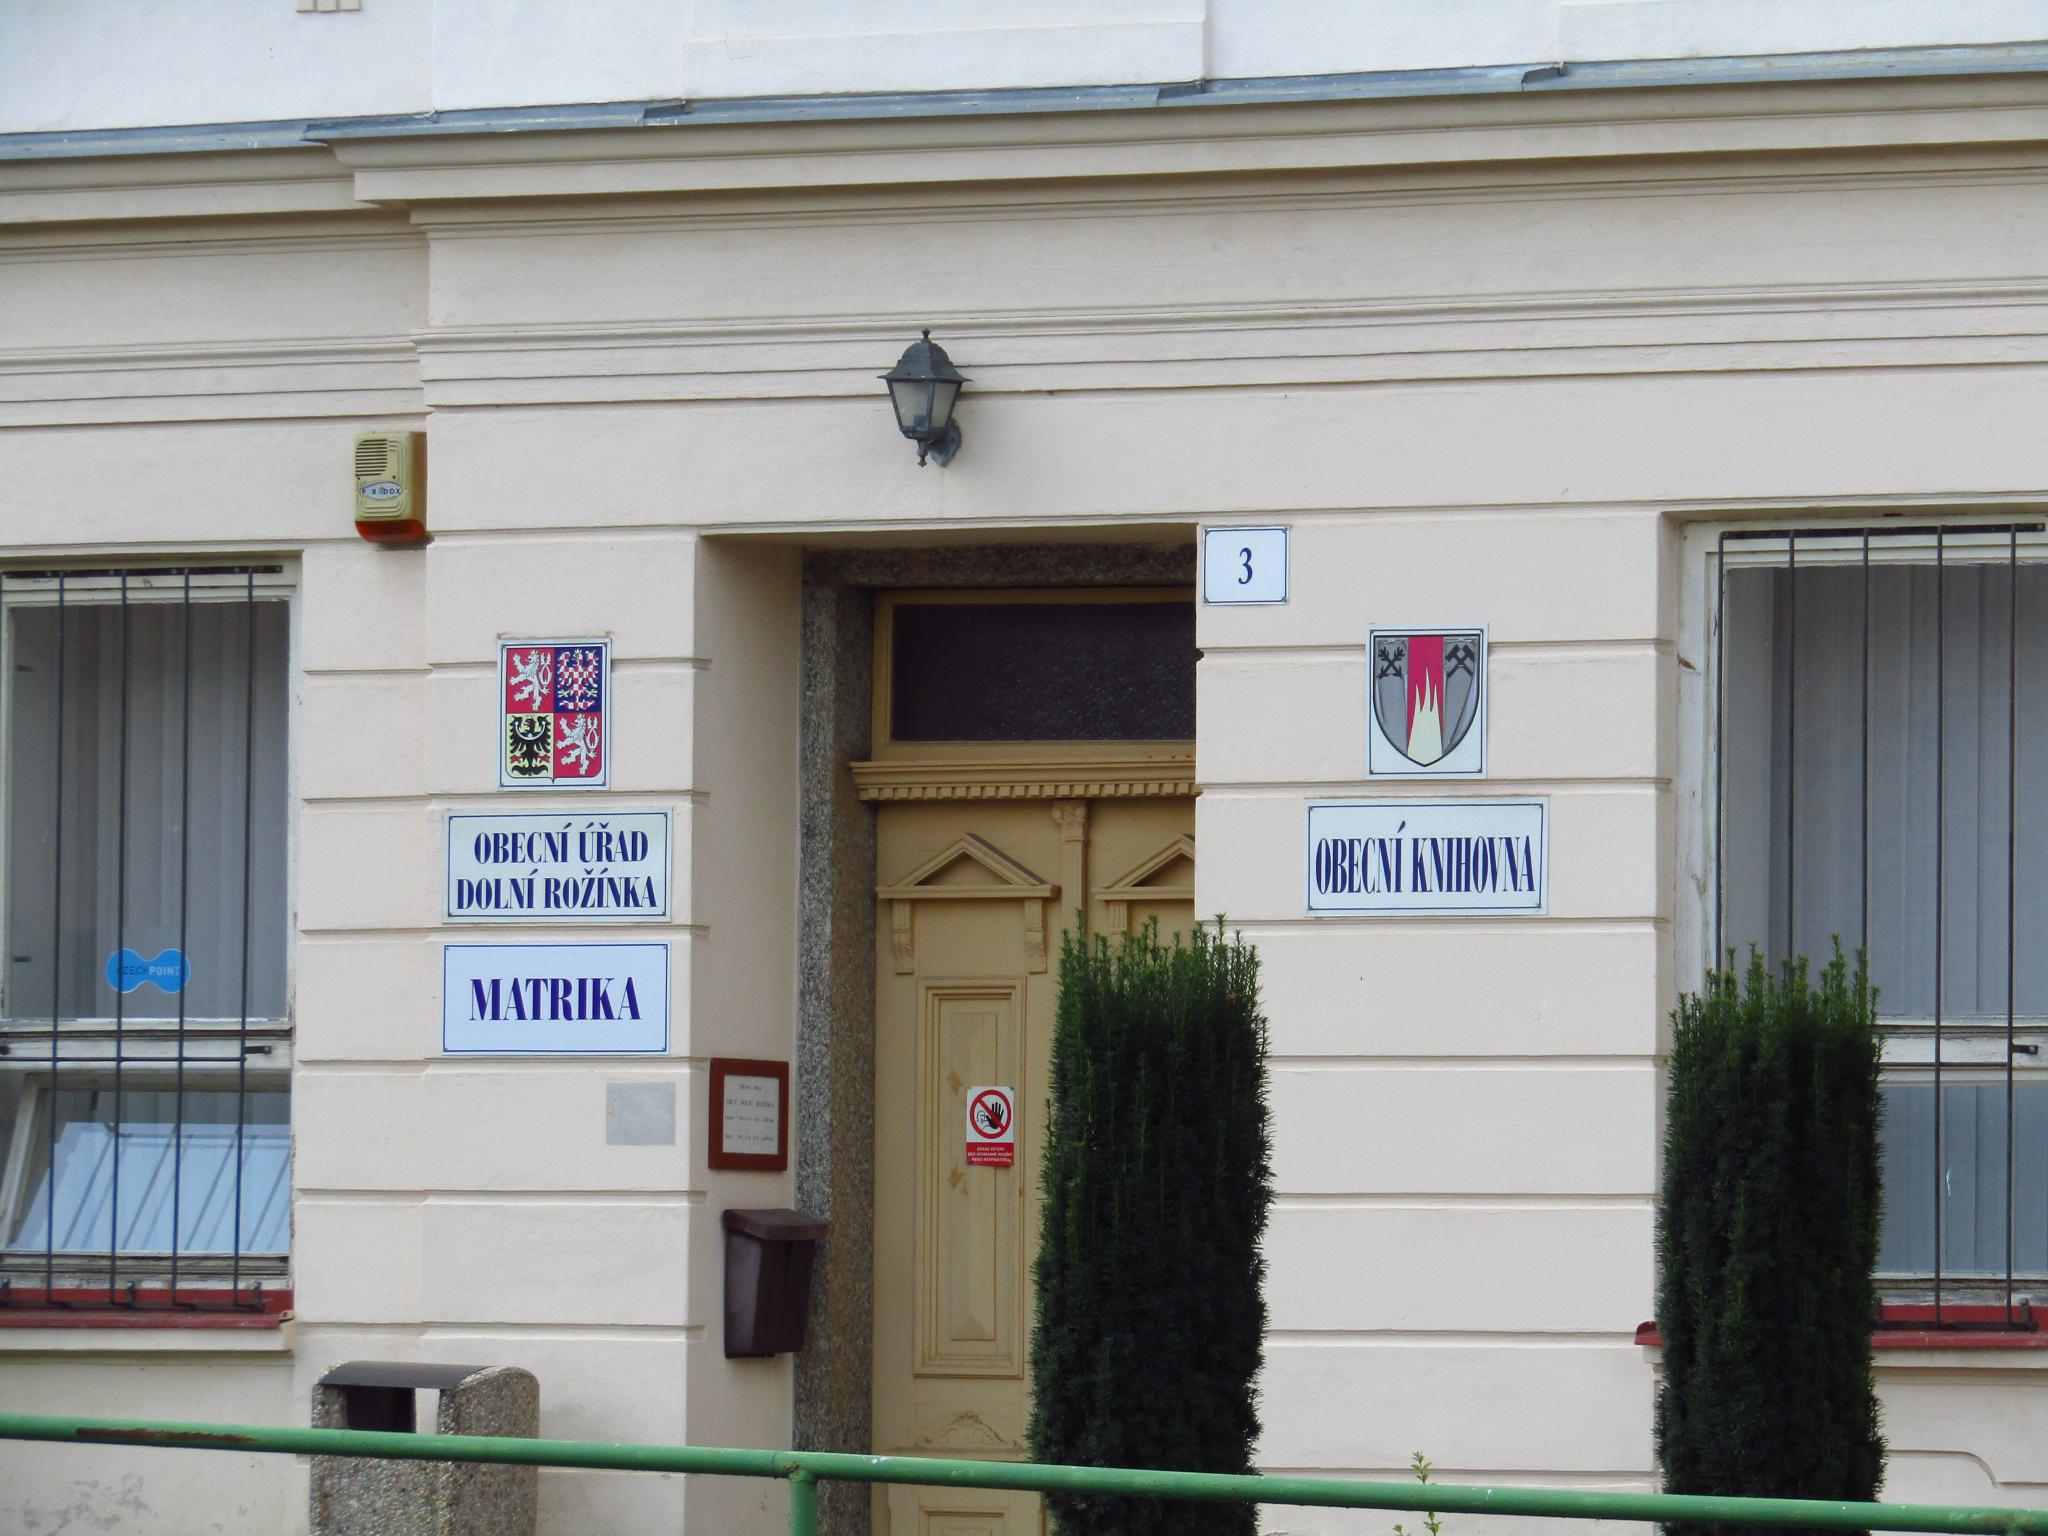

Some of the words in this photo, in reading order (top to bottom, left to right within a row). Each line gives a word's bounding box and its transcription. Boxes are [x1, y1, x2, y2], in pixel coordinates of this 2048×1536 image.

[1238, 547, 1253, 584] 3
[474, 822, 572, 864] OBECNÍ
[579, 821, 649, 863] ÚŘAD
[1315, 820, 1406, 894] OBECNÍ
[1411, 835, 1536, 893] KNIHOVNA
[456, 868, 538, 910] DOLNÍ
[544, 867, 658, 909] ROŽÍNKA
[469, 976, 642, 1021] MATRIKA
